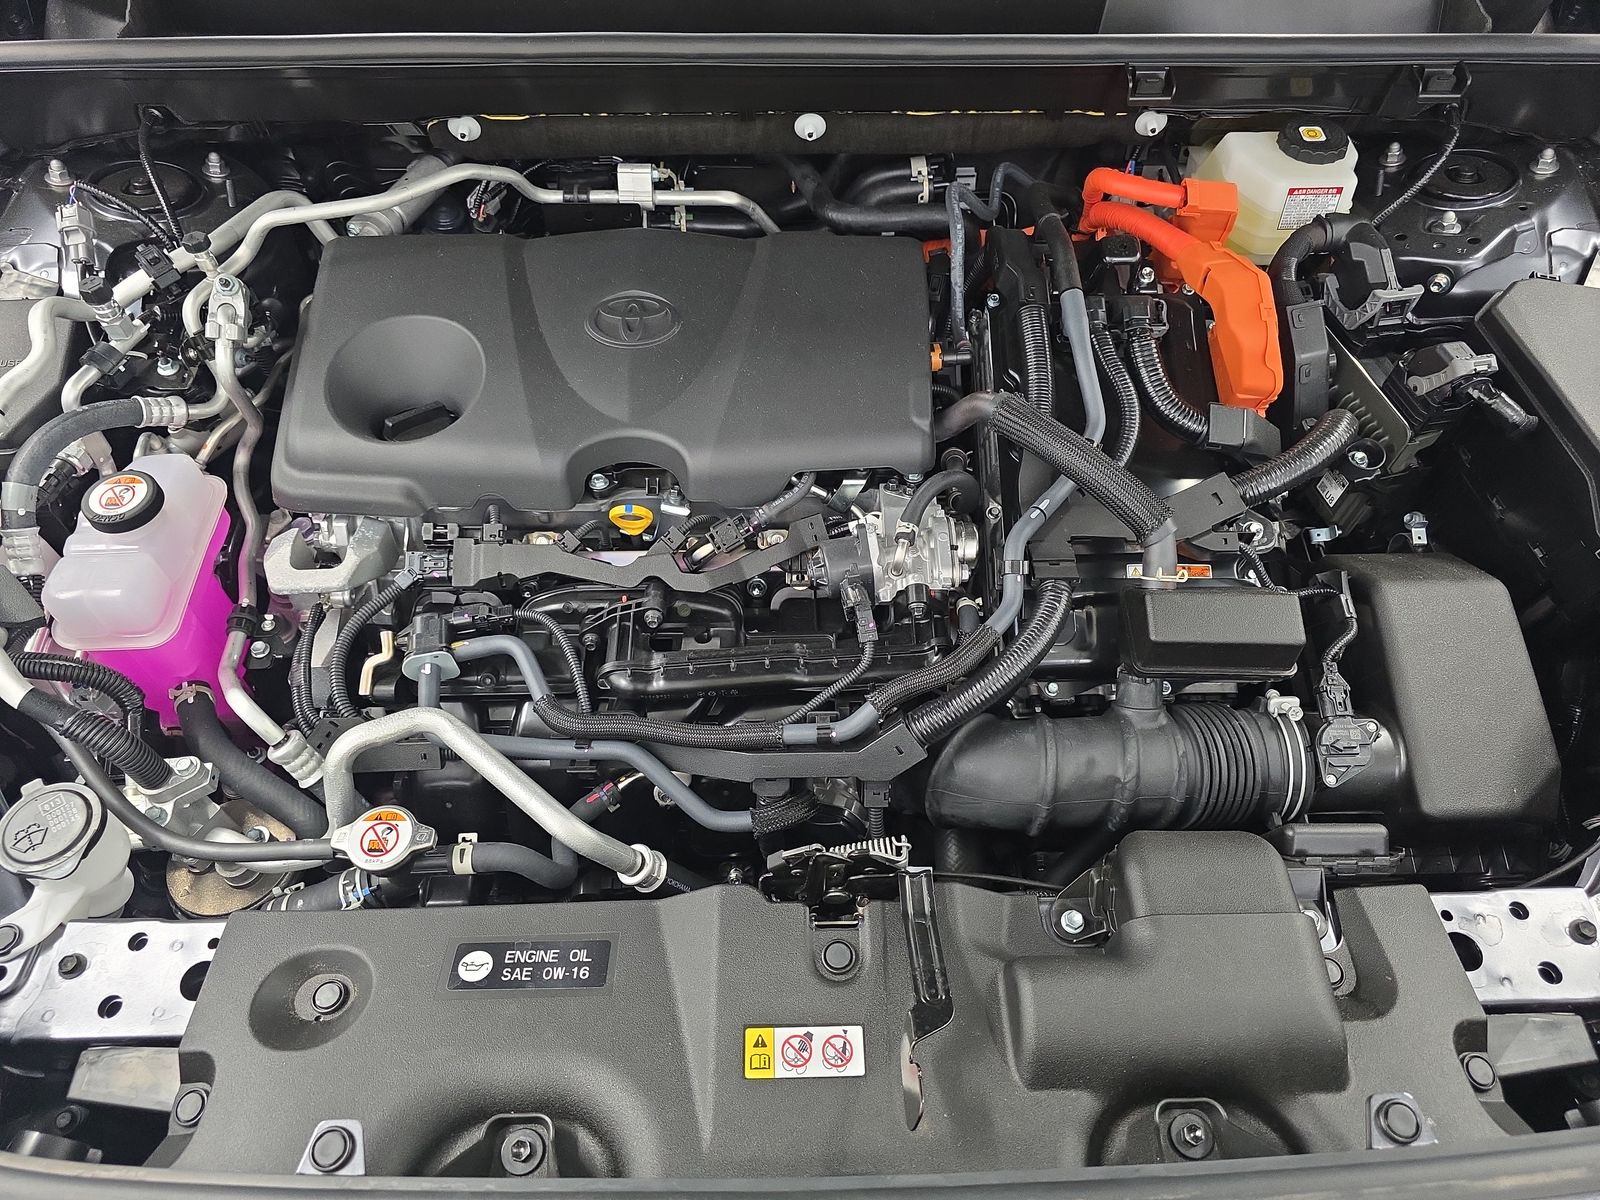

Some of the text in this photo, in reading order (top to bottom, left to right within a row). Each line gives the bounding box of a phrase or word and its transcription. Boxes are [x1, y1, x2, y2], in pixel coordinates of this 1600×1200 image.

[1324, 490, 1335, 505] U8
[91, 513, 126, 522] DENSO
[504, 949, 592, 964] ENGINE OIL
[500, 967, 533, 981] SAE
